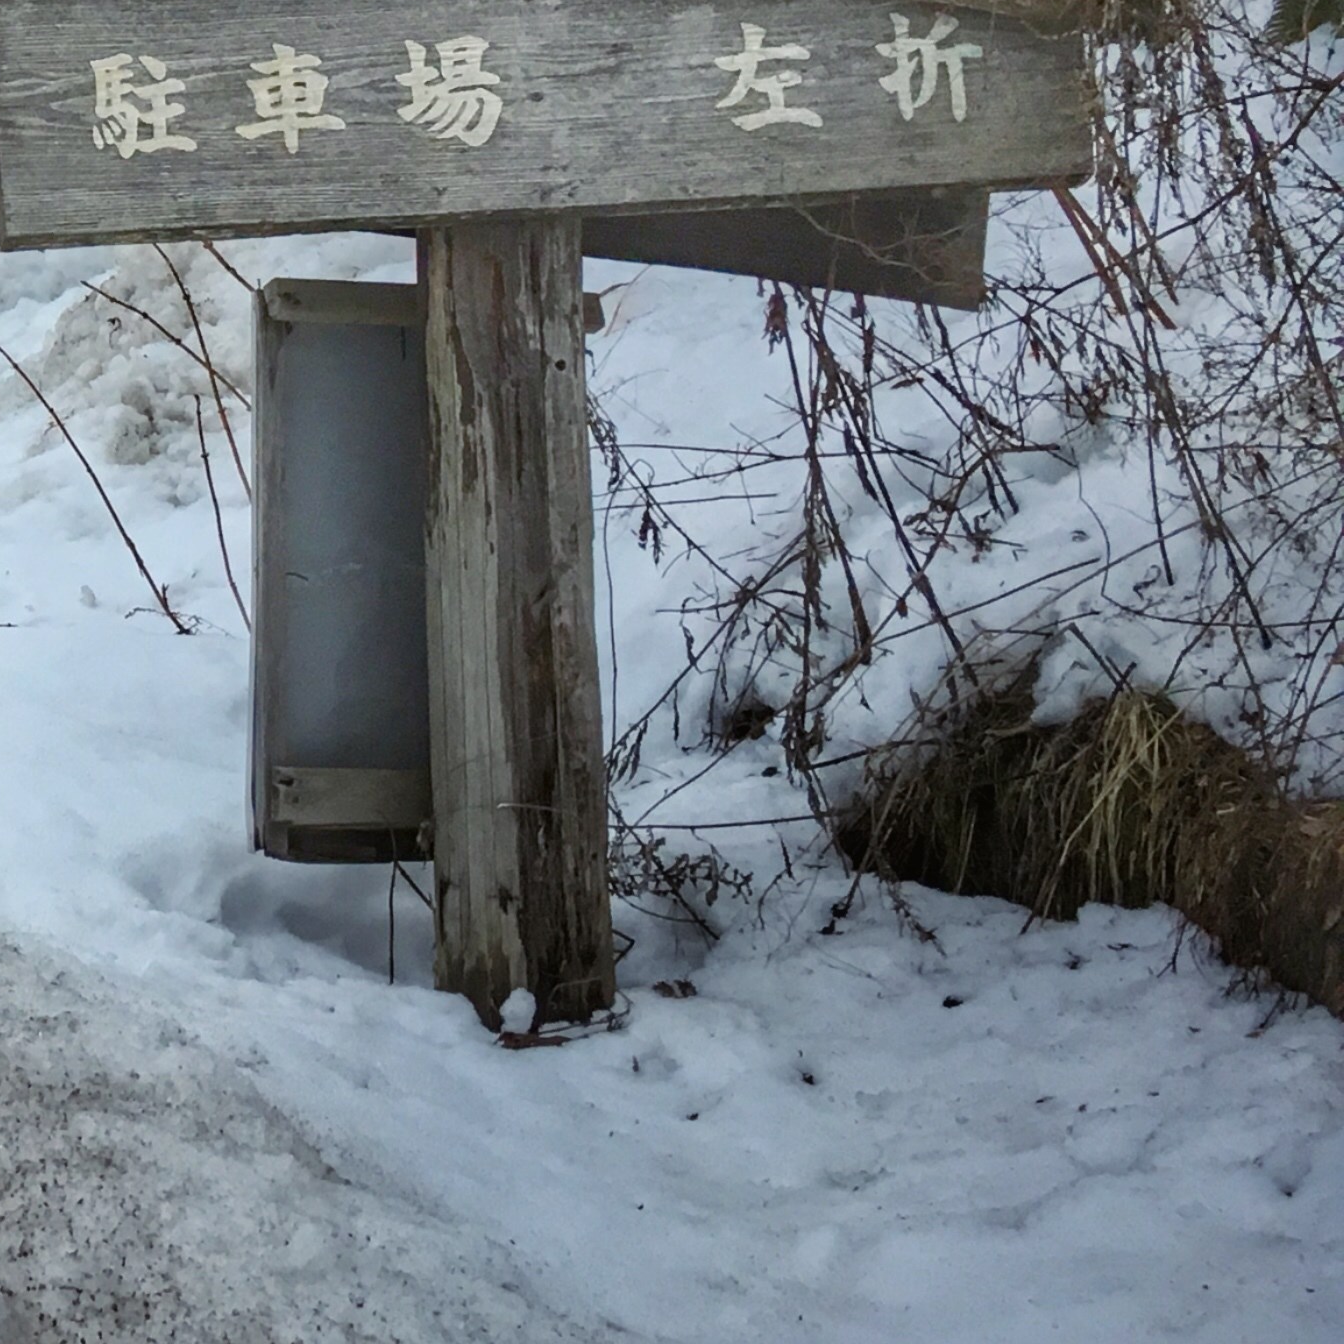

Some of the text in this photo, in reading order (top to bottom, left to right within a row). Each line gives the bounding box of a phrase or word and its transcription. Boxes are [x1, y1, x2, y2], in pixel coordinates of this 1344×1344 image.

[89, 10, 984, 160] 駐車場 左折
